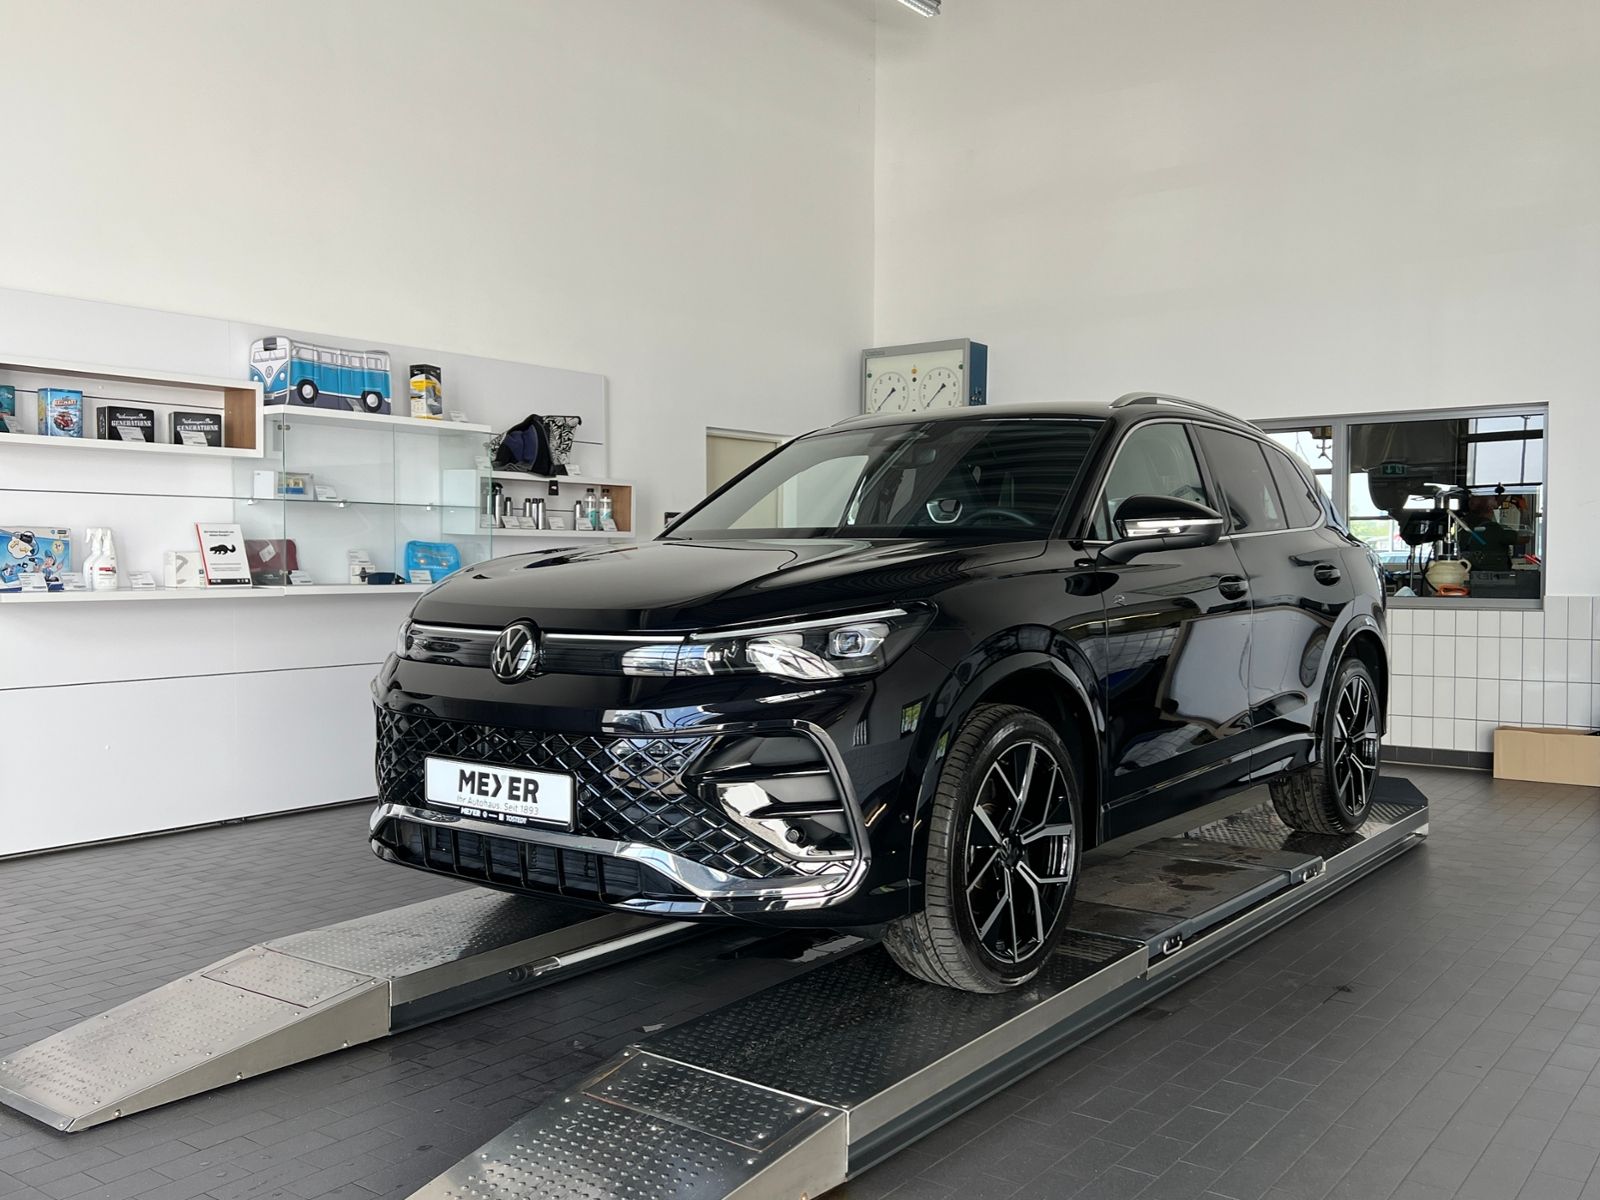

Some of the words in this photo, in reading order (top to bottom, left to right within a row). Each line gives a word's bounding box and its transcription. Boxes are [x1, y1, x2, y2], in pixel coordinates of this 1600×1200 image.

[458, 769, 539, 804] MEYER
[504, 802, 518, 813] Seit
[520, 804, 539, 816] 1893
